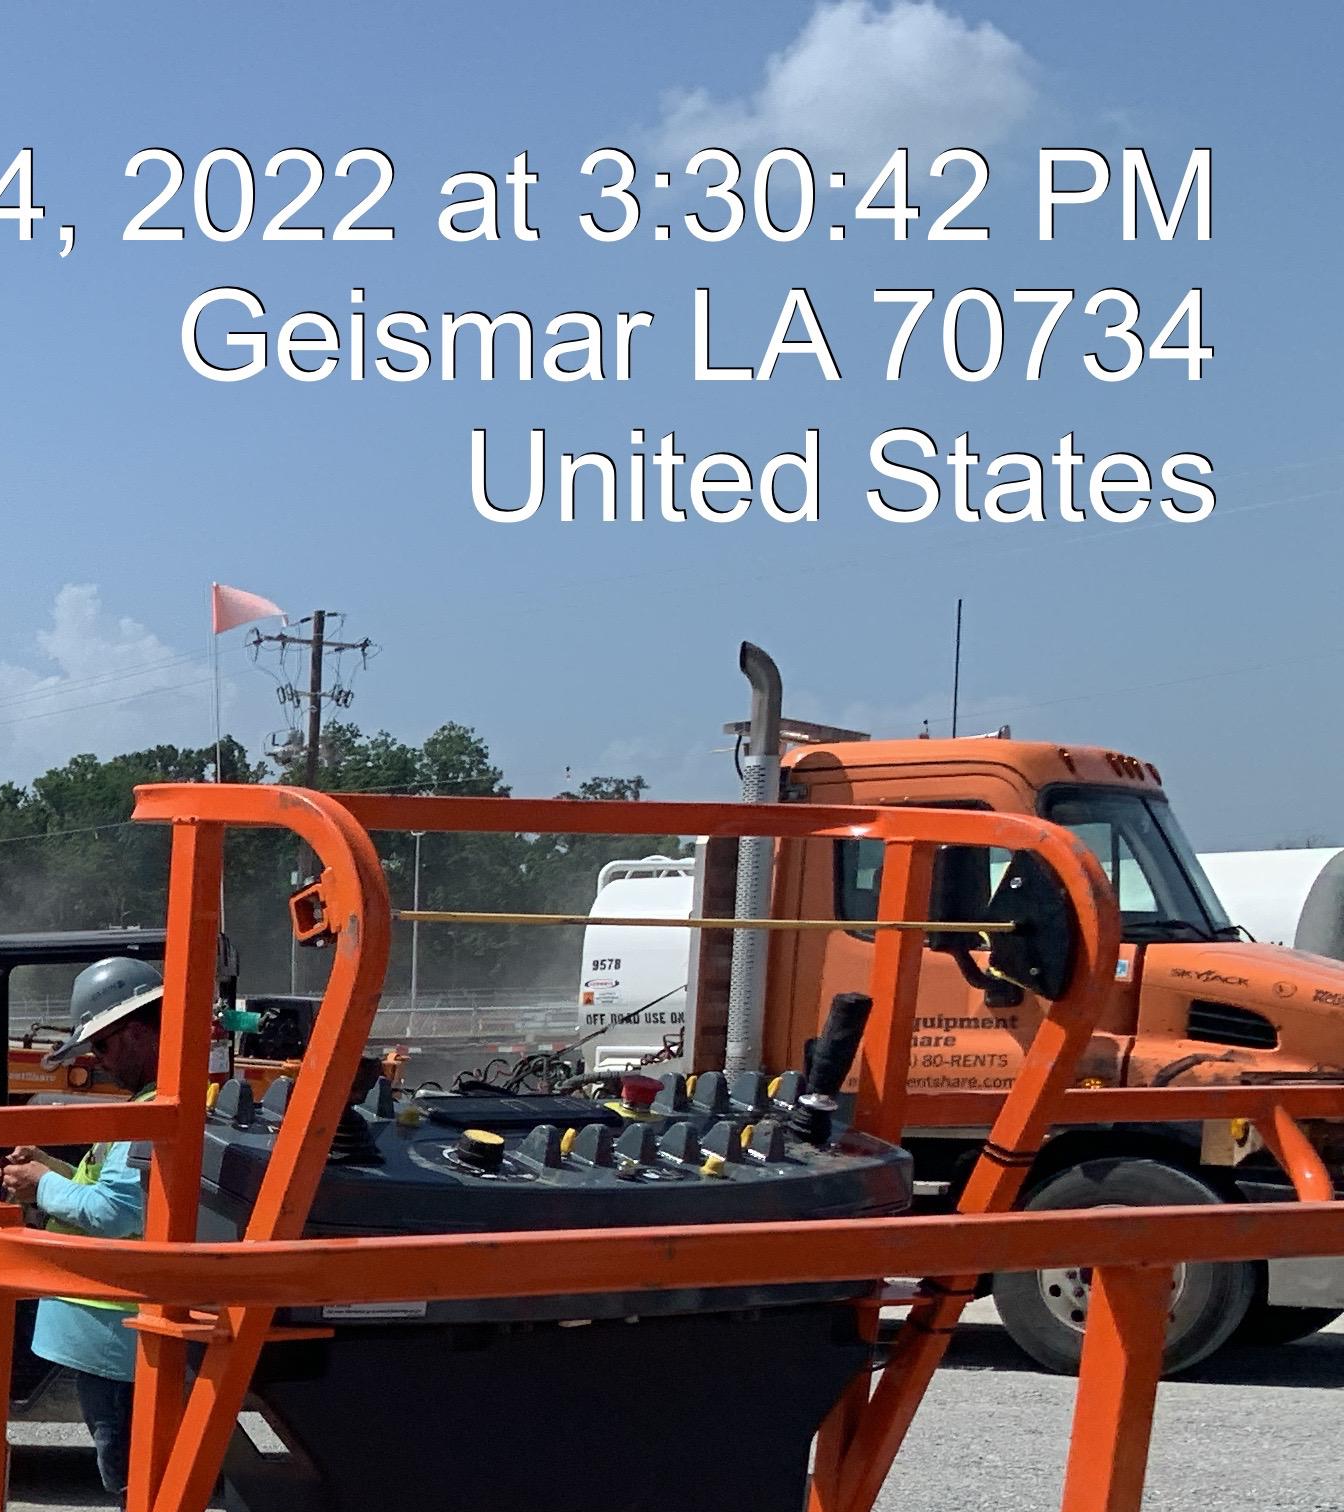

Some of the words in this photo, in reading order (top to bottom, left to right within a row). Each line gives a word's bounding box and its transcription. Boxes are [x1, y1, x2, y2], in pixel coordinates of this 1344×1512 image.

[592, 958, 621, 971] 9578
[586, 1013, 606, 1026] OFF
[644, 1012, 666, 1024] USE
[670, 1011, 685, 1024] ON
[912, 1013, 1018, 1031] quipment
[921, 1053, 1009, 1068] 80-RENTS
